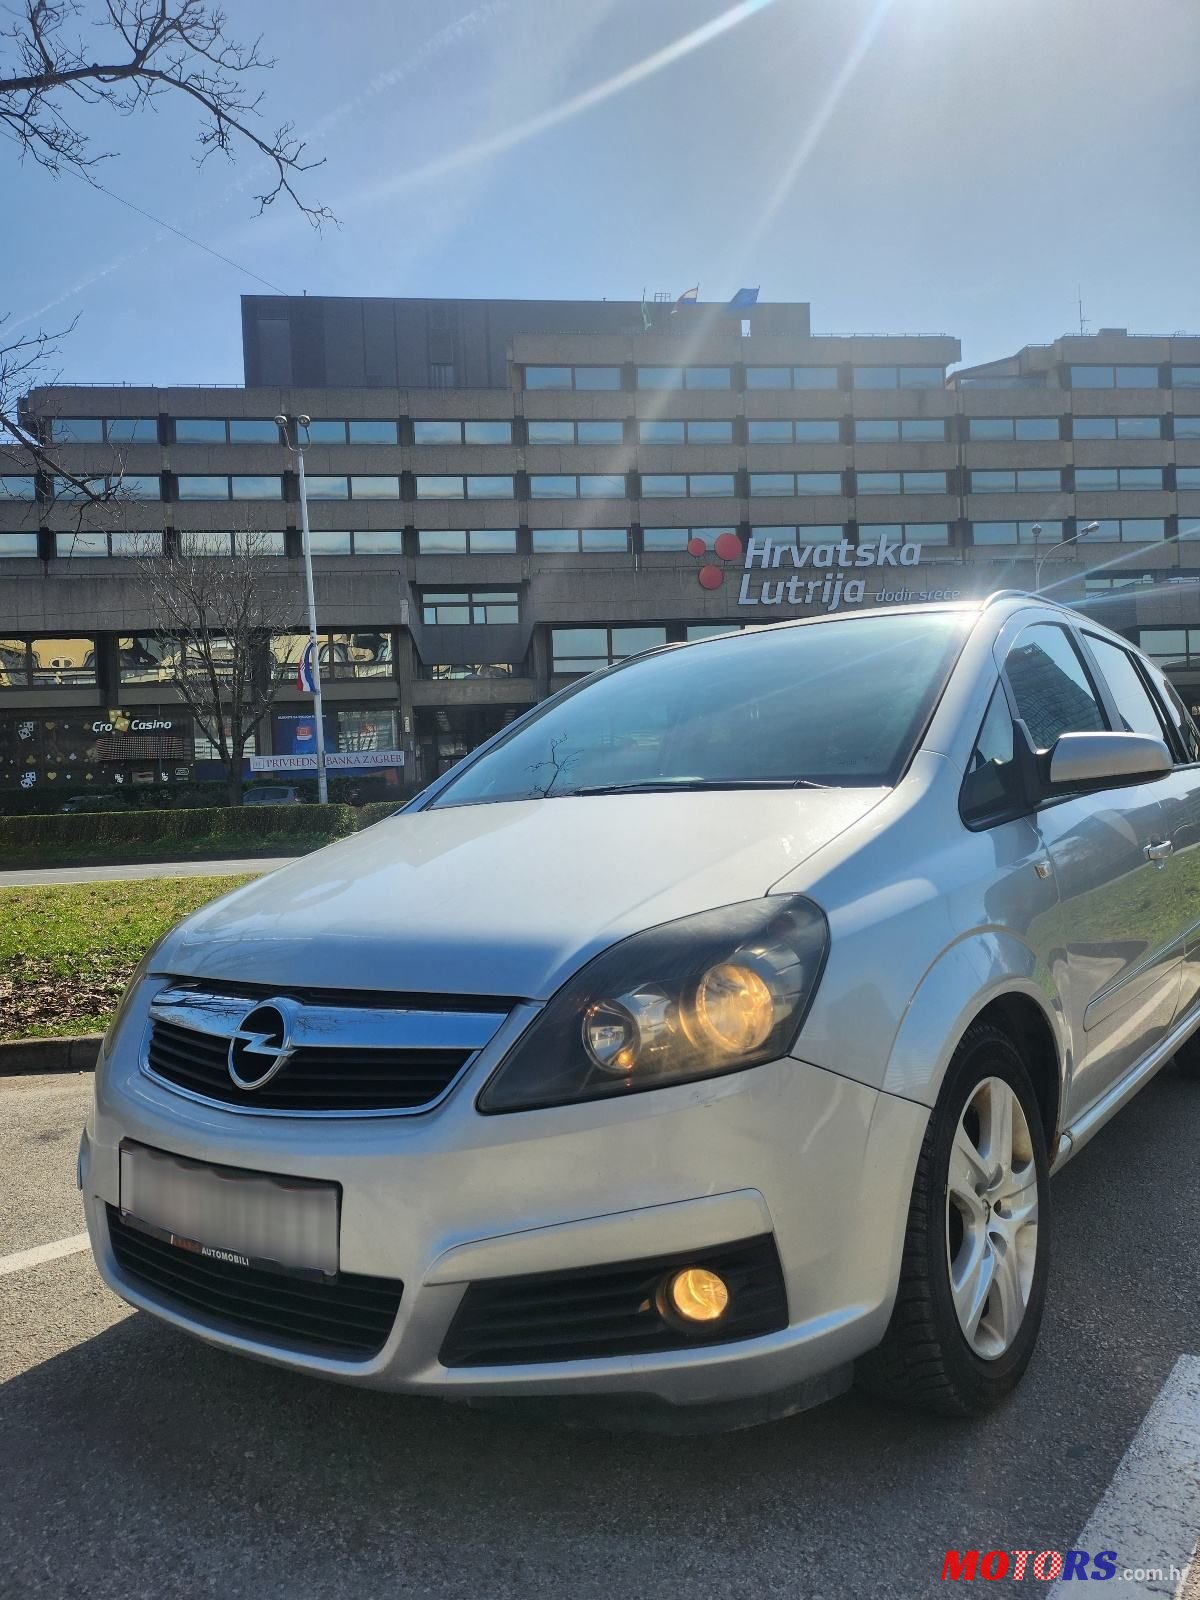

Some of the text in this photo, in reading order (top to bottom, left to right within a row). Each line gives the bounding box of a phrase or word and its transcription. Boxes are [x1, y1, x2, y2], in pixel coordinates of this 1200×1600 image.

[744, 533, 922, 569] Hrvatska
[737, 572, 866, 611] Lutrija
[875, 588, 915, 602] dodir
[92, 719, 172, 733] Cro Casino
[266, 752, 402, 768] PRIVREDN BANKA ZAGREB
[201, 1247, 249, 1266] AUTOMOBILI
